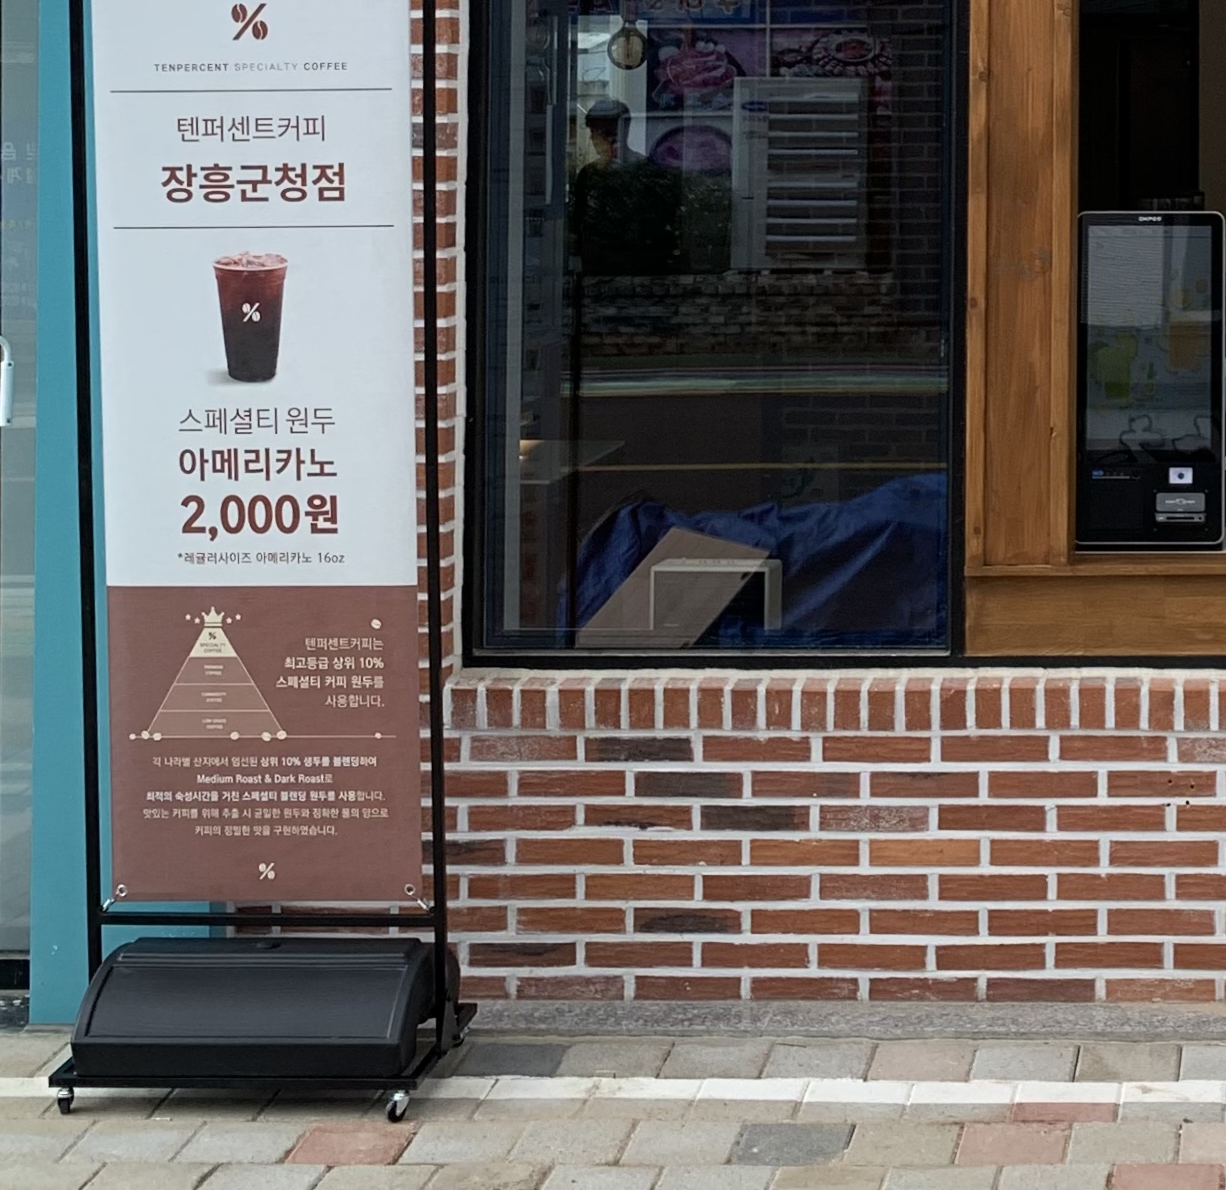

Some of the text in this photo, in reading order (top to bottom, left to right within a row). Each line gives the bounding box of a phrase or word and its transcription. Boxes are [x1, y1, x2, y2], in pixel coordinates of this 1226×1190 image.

[153, 61, 348, 72] TENPERCENT SPECIALTY COFFEE
[177, 114, 326, 143] 텐퍼센트커피
[161, 162, 345, 204] 장흥군청점
[178, 407, 336, 435] 스페셜티 원두
[179, 447, 338, 481] 아메리카노
[181, 494, 339, 542] 2,000원
[256, 551, 313, 565] 아메리카노
[317, 551, 346, 564] 16oz
[304, 637, 384, 651] 텐퍼센트커피는
[284, 656, 385, 670] 최고등급 상위 10%
[275, 675, 385, 689] 스페셜티 커피 원두를
[324, 694, 385, 708] 사용합니다.
[260, 756, 279, 768] 상위
[281, 756, 302, 767] 10%
[196, 773, 333, 784] Medium Roast & Dark Roast로
[338, 791, 386, 802] 사용합니다.
